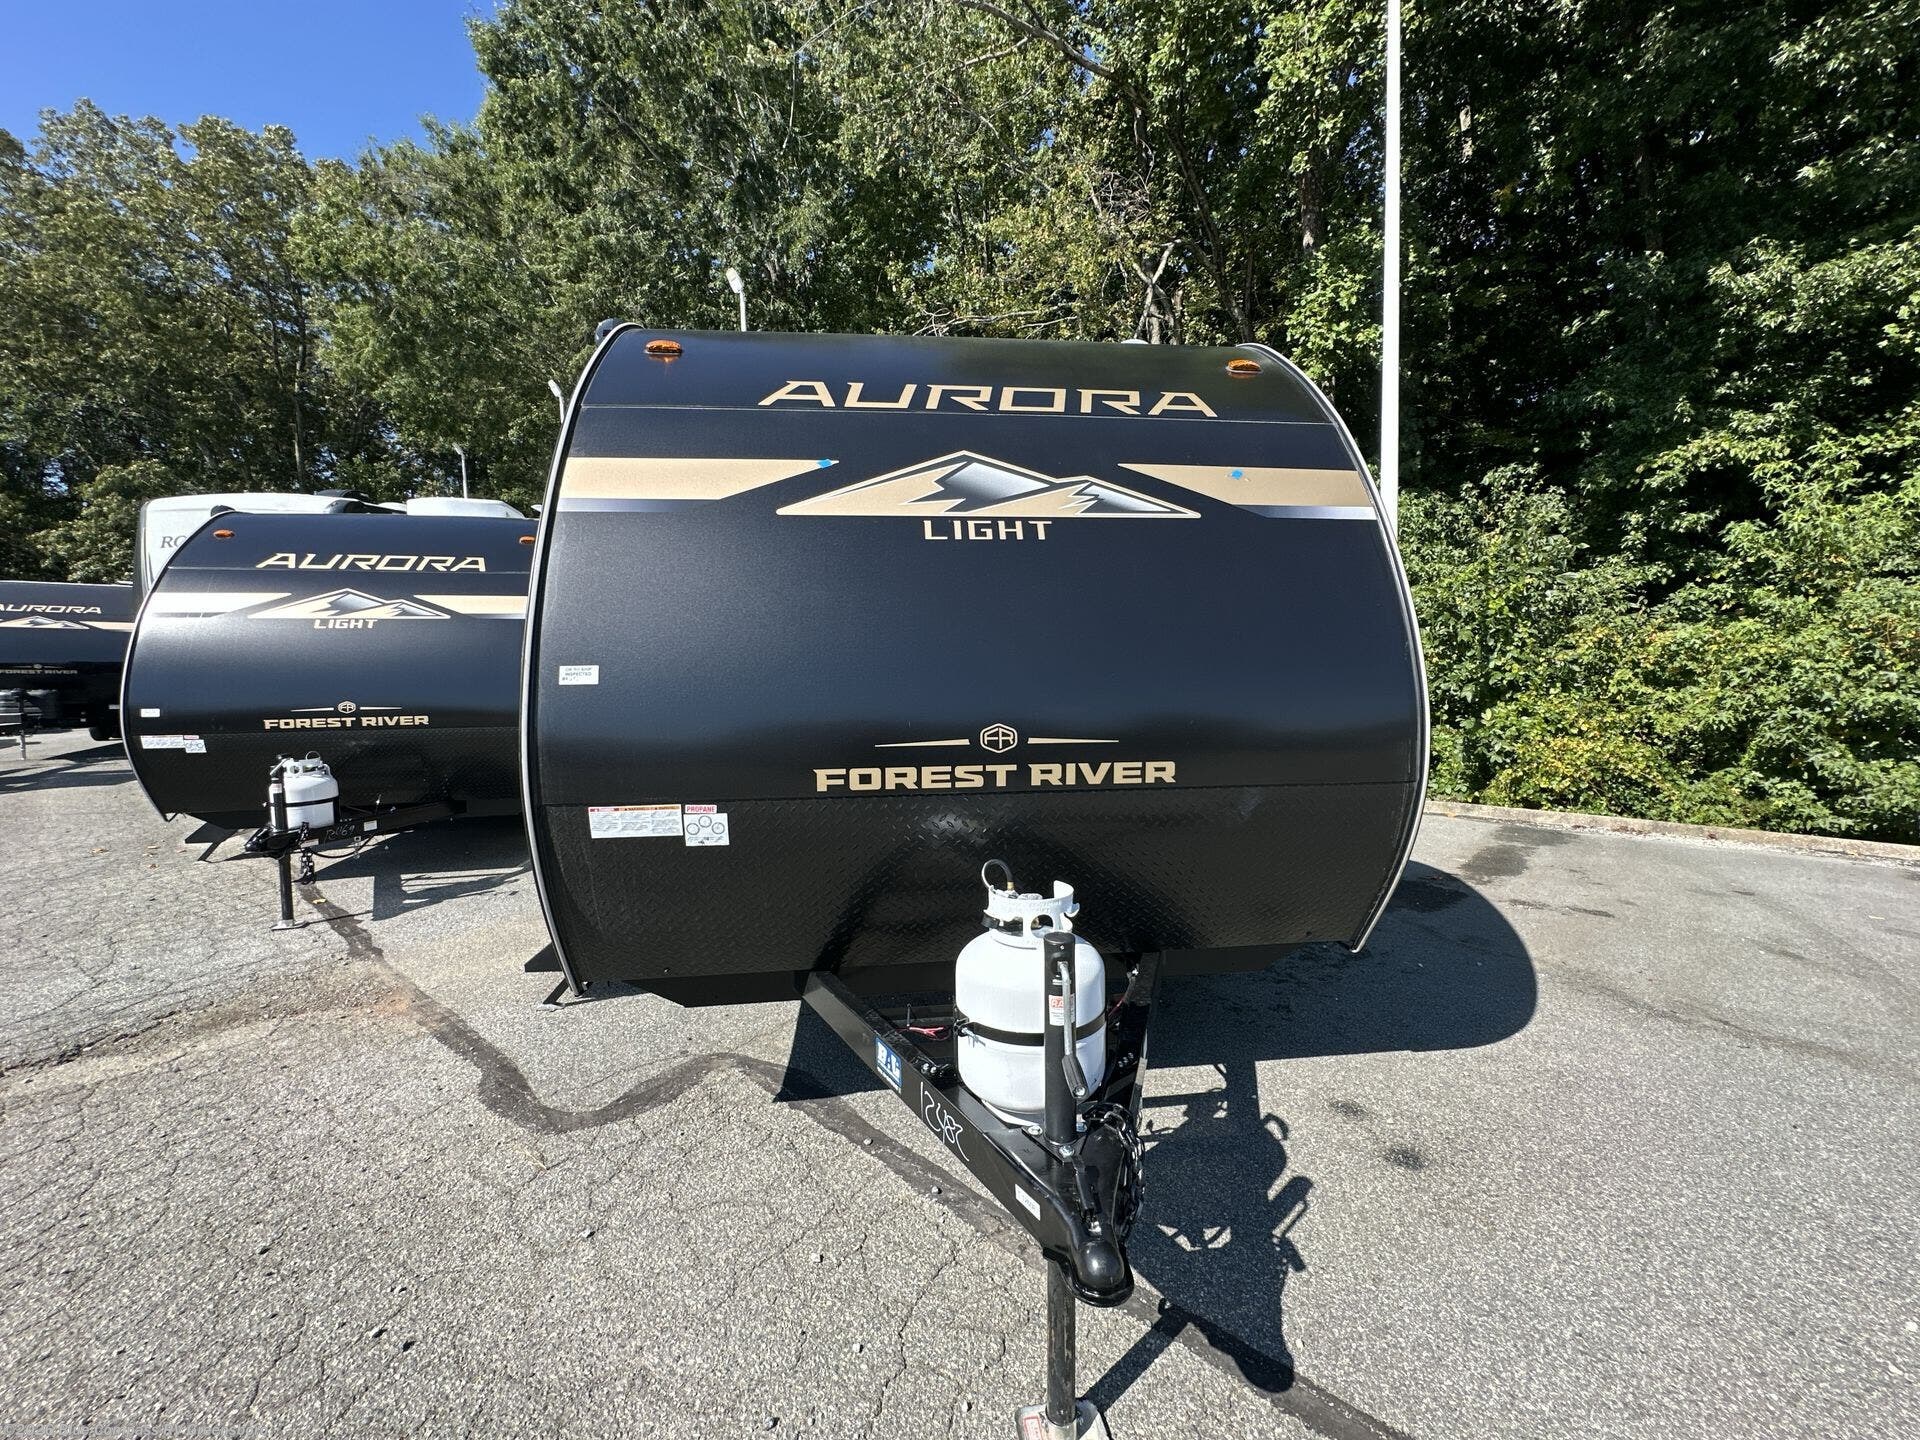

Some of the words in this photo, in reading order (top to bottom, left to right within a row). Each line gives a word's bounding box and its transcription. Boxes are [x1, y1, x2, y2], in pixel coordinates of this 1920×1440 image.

[758, 380, 1218, 418] AURORA
[923, 520, 1053, 541] LIGHT
[256, 553, 487, 572] AURORA
[0, 604, 102, 614] URORA
[313, 618, 378, 629] LIGHT
[263, 718, 356, 730] FOREST
[360, 715, 430, 727] RIVER
[812, 764, 1018, 793] FOREST
[1027, 760, 1176, 787] RIVER
[686, 805, 716, 813] PROPANE
